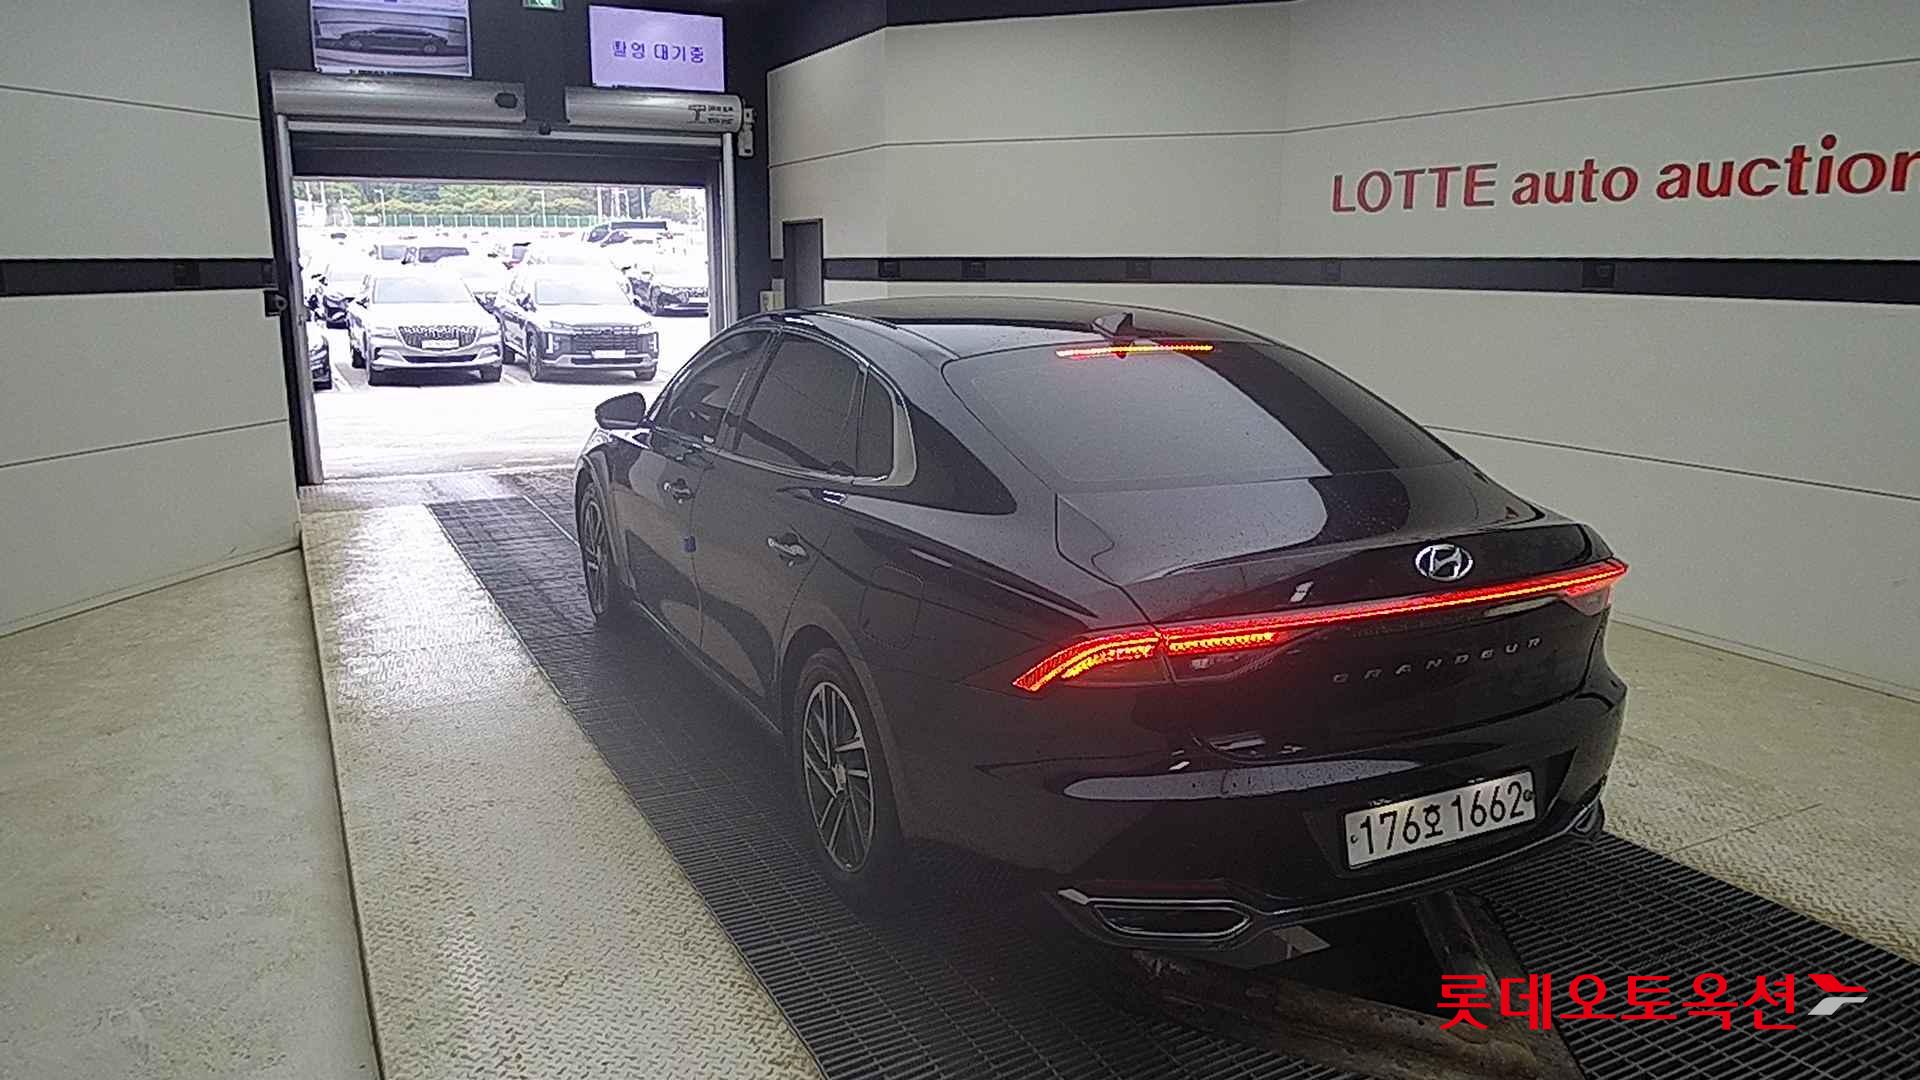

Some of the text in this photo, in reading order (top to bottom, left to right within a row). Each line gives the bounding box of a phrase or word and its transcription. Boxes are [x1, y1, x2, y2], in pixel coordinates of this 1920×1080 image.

[1331, 161, 1499, 213] LOTTE
[1511, 158, 1638, 206] auto
[1332, 636, 1542, 684] GRANDEUR
